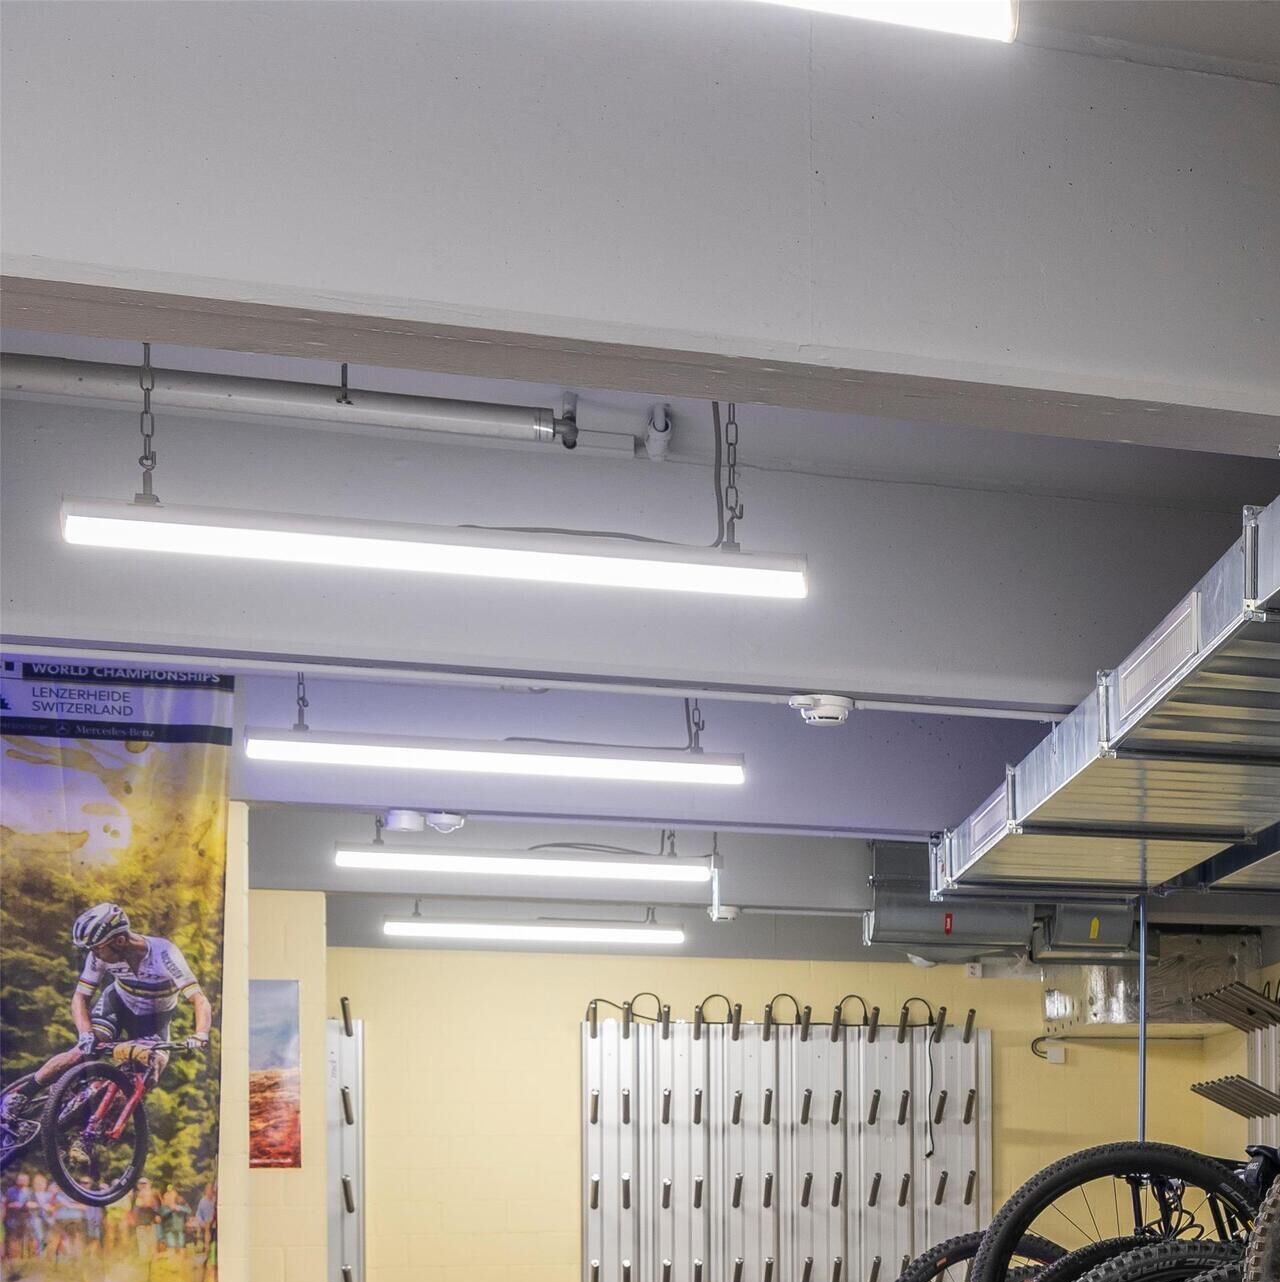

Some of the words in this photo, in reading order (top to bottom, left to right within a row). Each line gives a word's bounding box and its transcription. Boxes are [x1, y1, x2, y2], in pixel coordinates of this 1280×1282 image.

[32, 663, 89, 677] WORLD
[32, 687, 131, 703] LENZERHEIDE
[32, 701, 134, 717] SWITZERLAND
